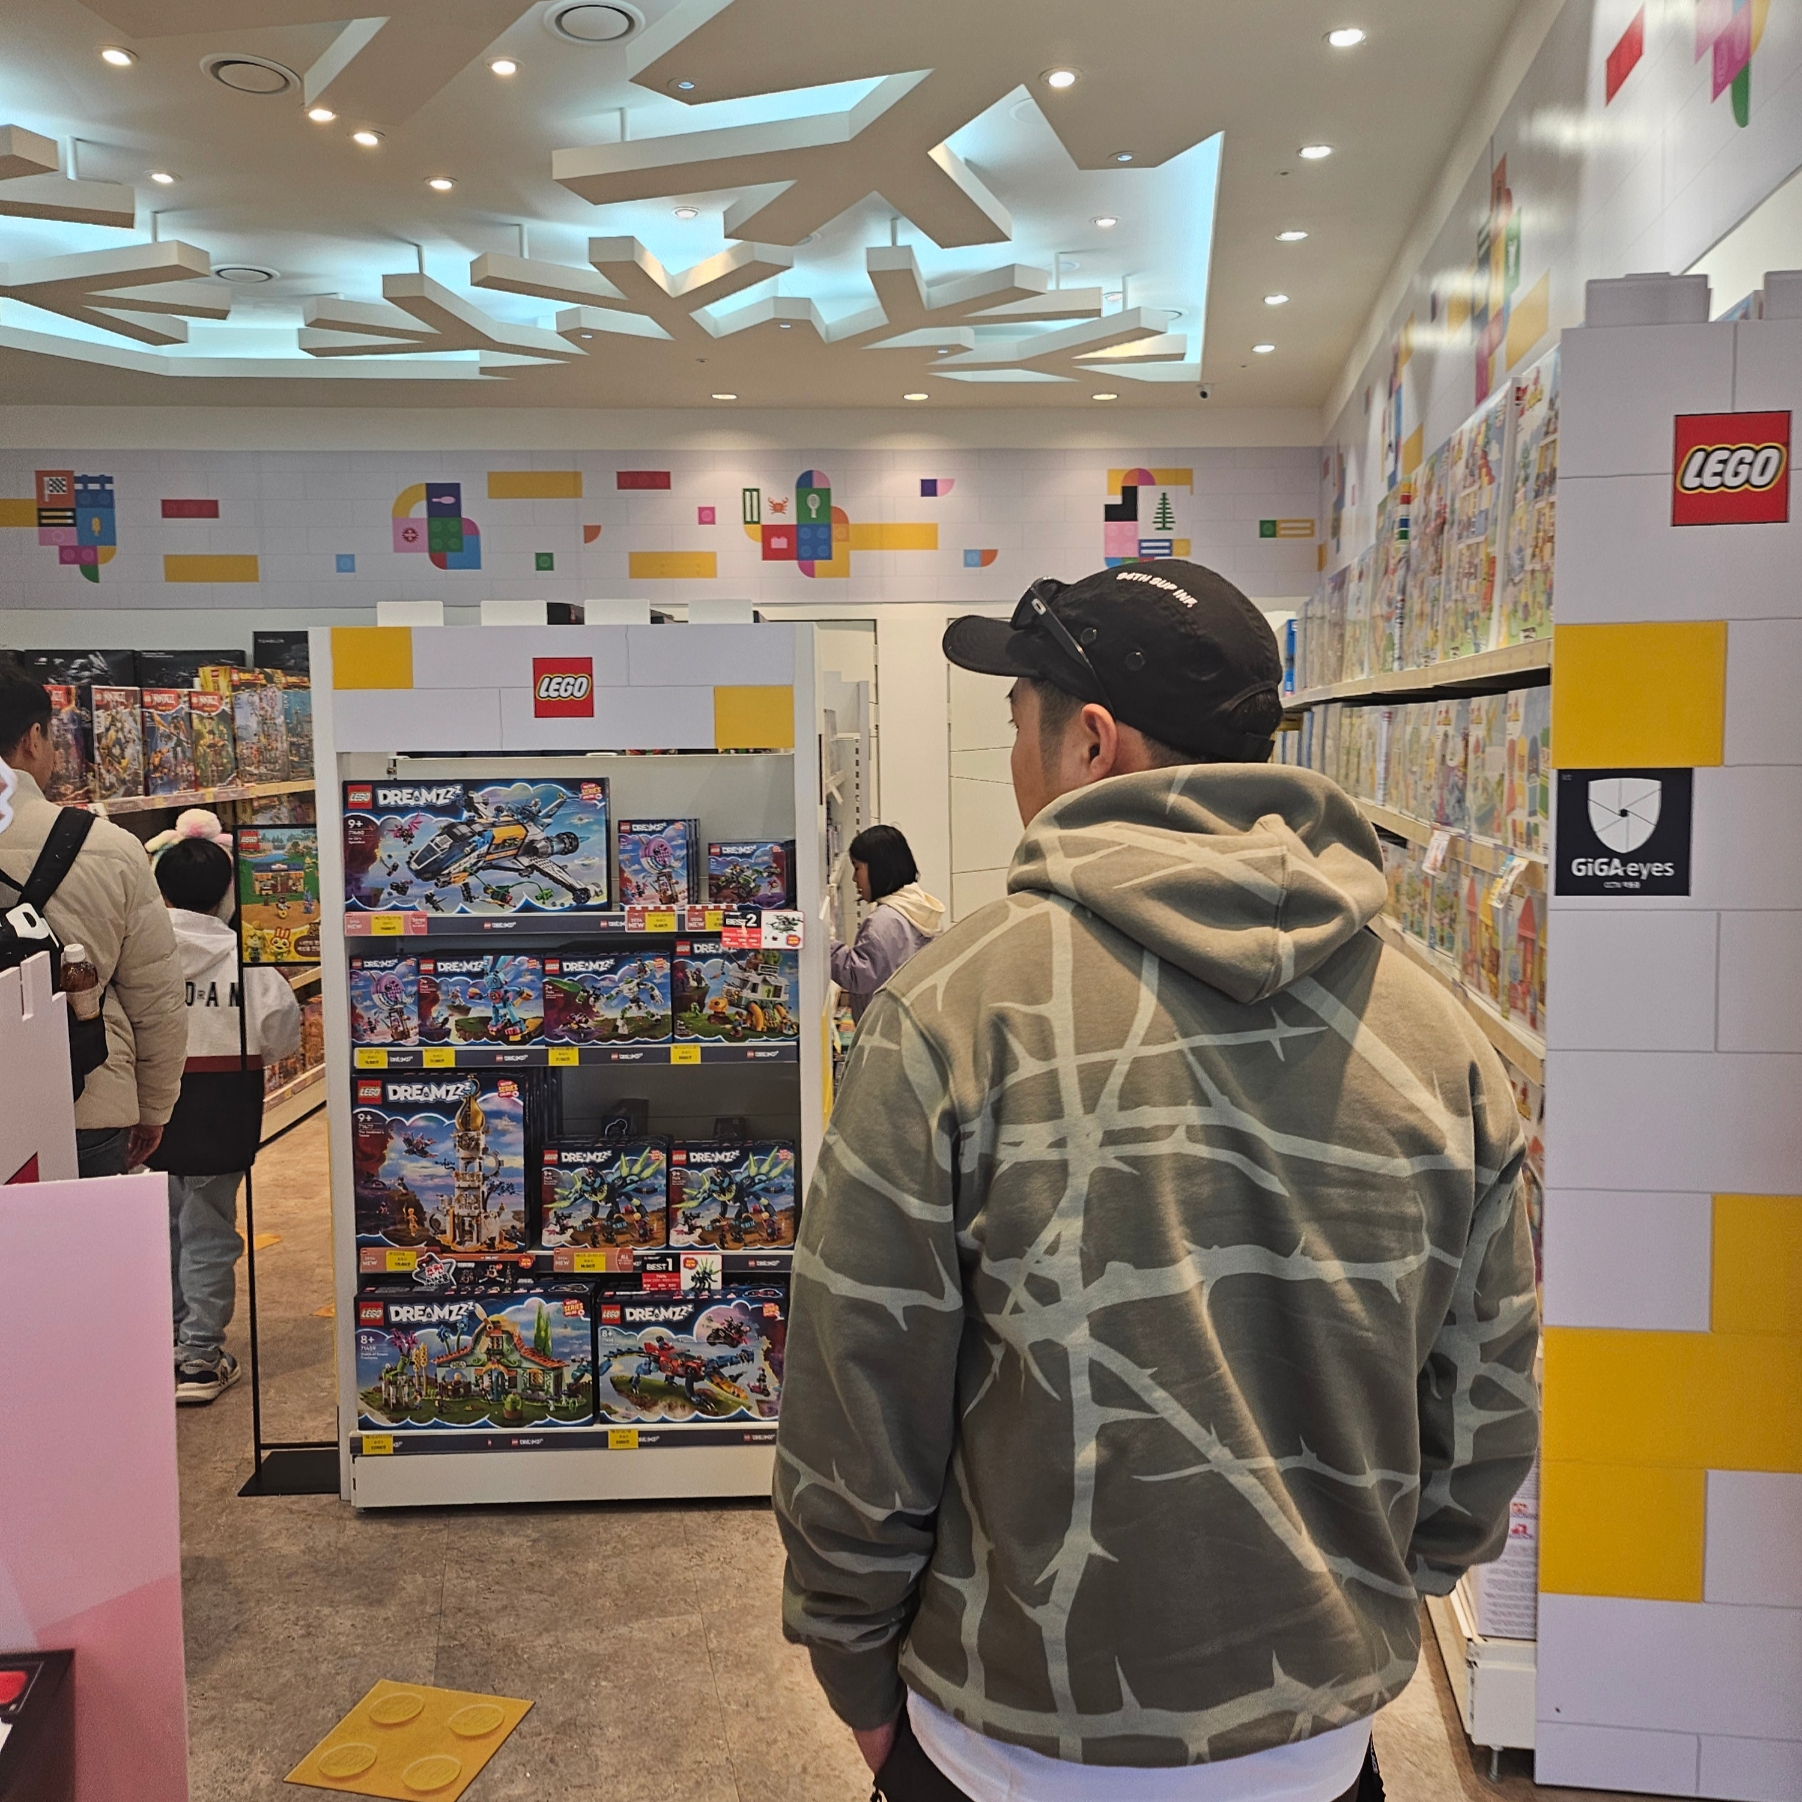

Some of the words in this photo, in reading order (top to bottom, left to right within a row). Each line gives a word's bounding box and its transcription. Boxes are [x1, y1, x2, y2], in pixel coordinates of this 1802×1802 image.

[1682, 448, 1783, 489] LEGO
[537, 676, 590, 699] LEGO
[349, 792, 371, 803] LEGO
[347, 819, 363, 828] 9+
[746, 914, 757, 926] 2
[359, 1088, 381, 1097] LEGO
[498, 1085, 518, 1093] SERIES
[358, 1114, 373, 1122] 9+
[666, 1258, 673, 1271] 1
[563, 1304, 584, 1312] SERIES
[361, 1309, 382, 1318] LEGO
[602, 1310, 620, 1318] LEGO
[360, 1335, 374, 1344] 8+
